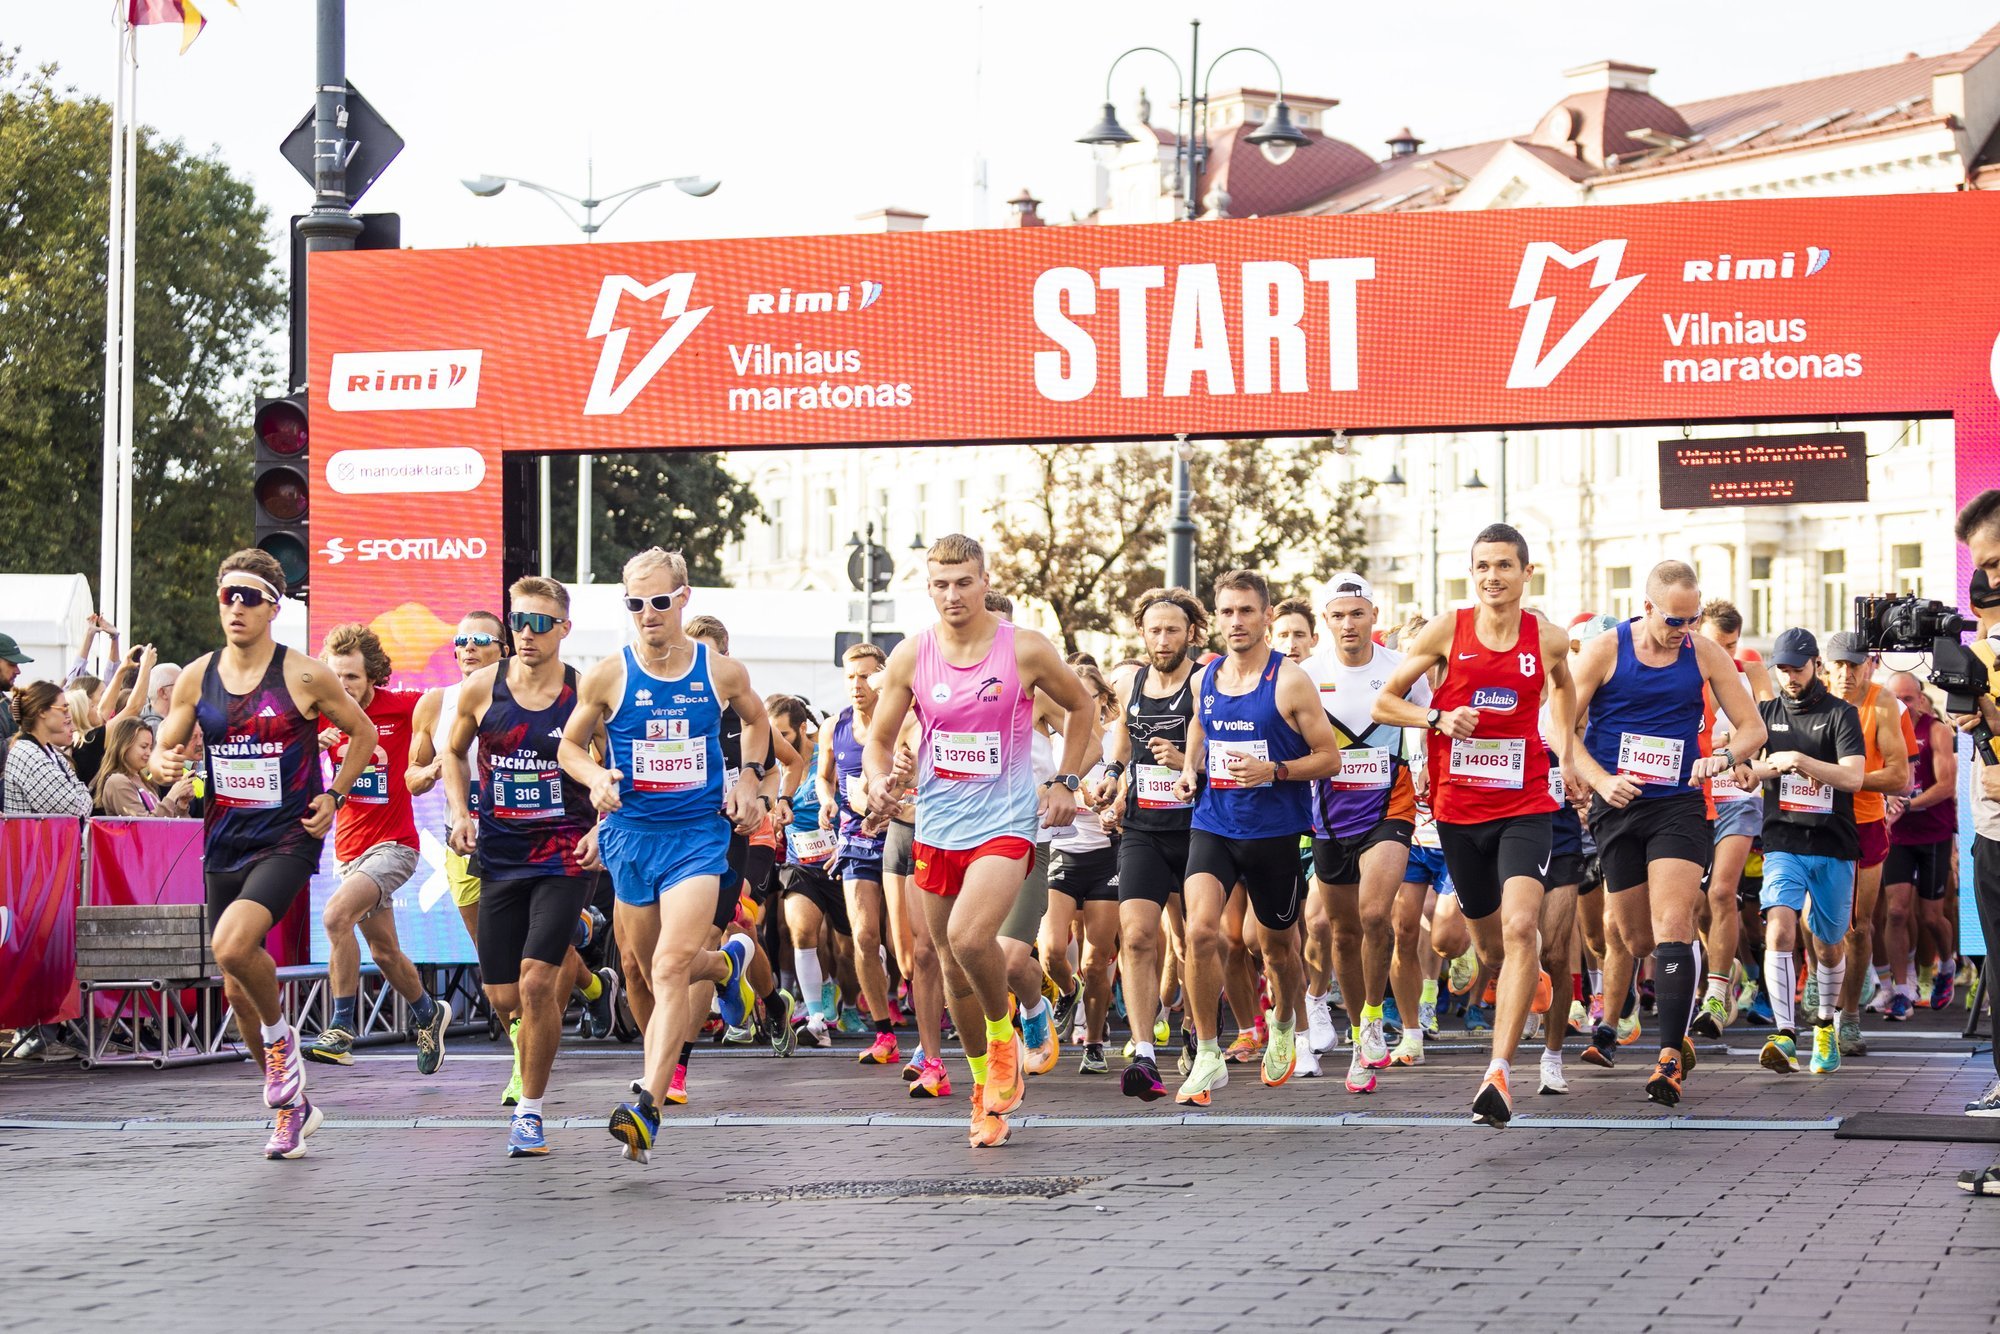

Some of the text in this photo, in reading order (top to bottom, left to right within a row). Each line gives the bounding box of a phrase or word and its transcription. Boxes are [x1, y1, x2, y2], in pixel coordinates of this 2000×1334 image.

[1032, 256, 1376, 402] START
[1661, 311, 1808, 347] Vilniaus
[728, 342, 862, 377] Vilniaus
[1662, 351, 1864, 384] maratonas
[728, 380, 913, 411] maratonas
[360, 463, 473, 478] manodaktaras.lt
[357, 537, 488, 562] SPORTLAND
[982, 695, 999, 703] RUN
[1473, 689, 1515, 706] Baltais
[229, 734, 252, 744] TOP
[517, 748, 538, 759] TOP
[944, 749, 986, 763] 13766
[1464, 754, 1509, 767] 14063
[1632, 751, 1671, 767] 14075
[649, 757, 692, 772] 13875
[1342, 762, 1378, 775] 13770
[225, 776, 266, 789] 13349
[352, 777, 372, 788] 69
[514, 787, 541, 801] 316
[805, 839, 827, 851] 12101
